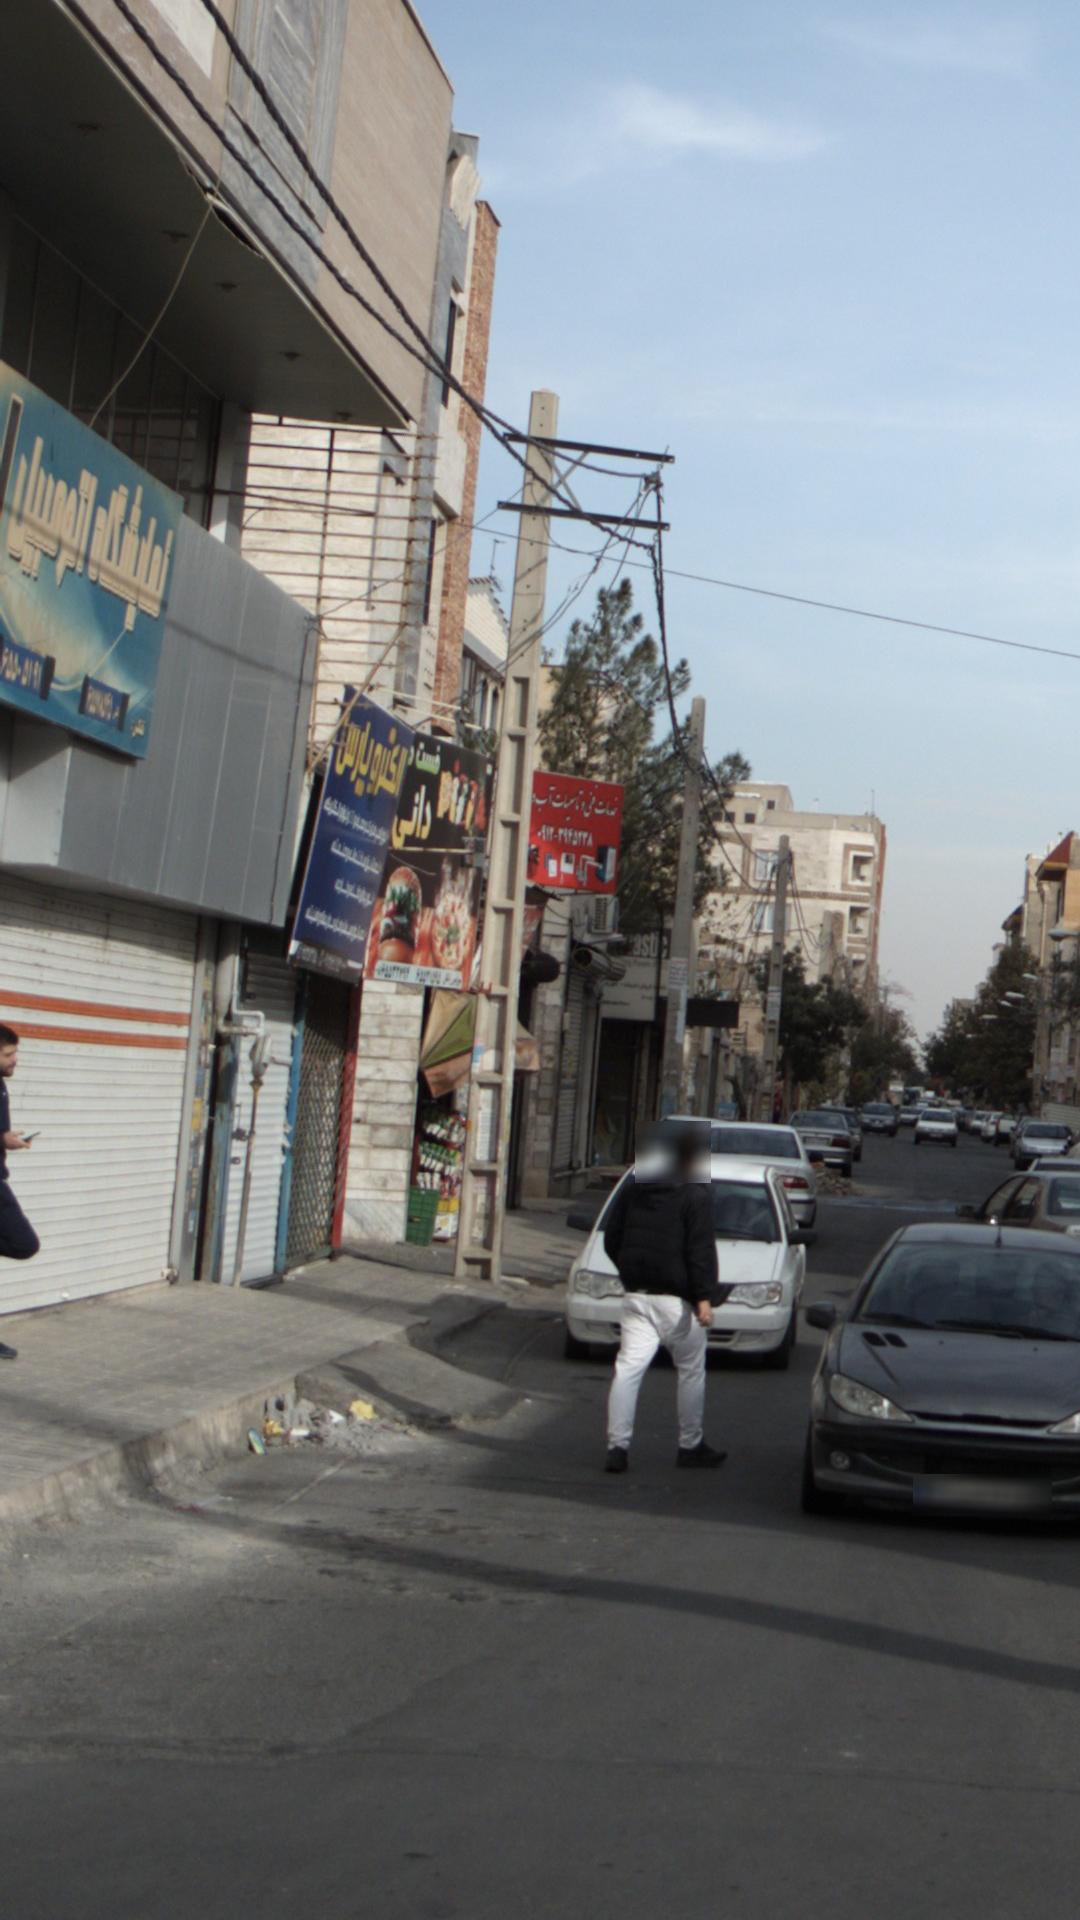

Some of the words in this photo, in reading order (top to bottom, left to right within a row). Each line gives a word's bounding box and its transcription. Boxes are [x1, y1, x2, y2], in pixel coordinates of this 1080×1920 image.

[7, 435, 99, 590] اتومبیل
[87, 484, 175, 632] نمایشگاه
[334, 721, 373, 797] پارس
[367, 727, 409, 799] الکترو
[415, 741, 441, 775] فست
[594, 797, 618, 816] خدمات
